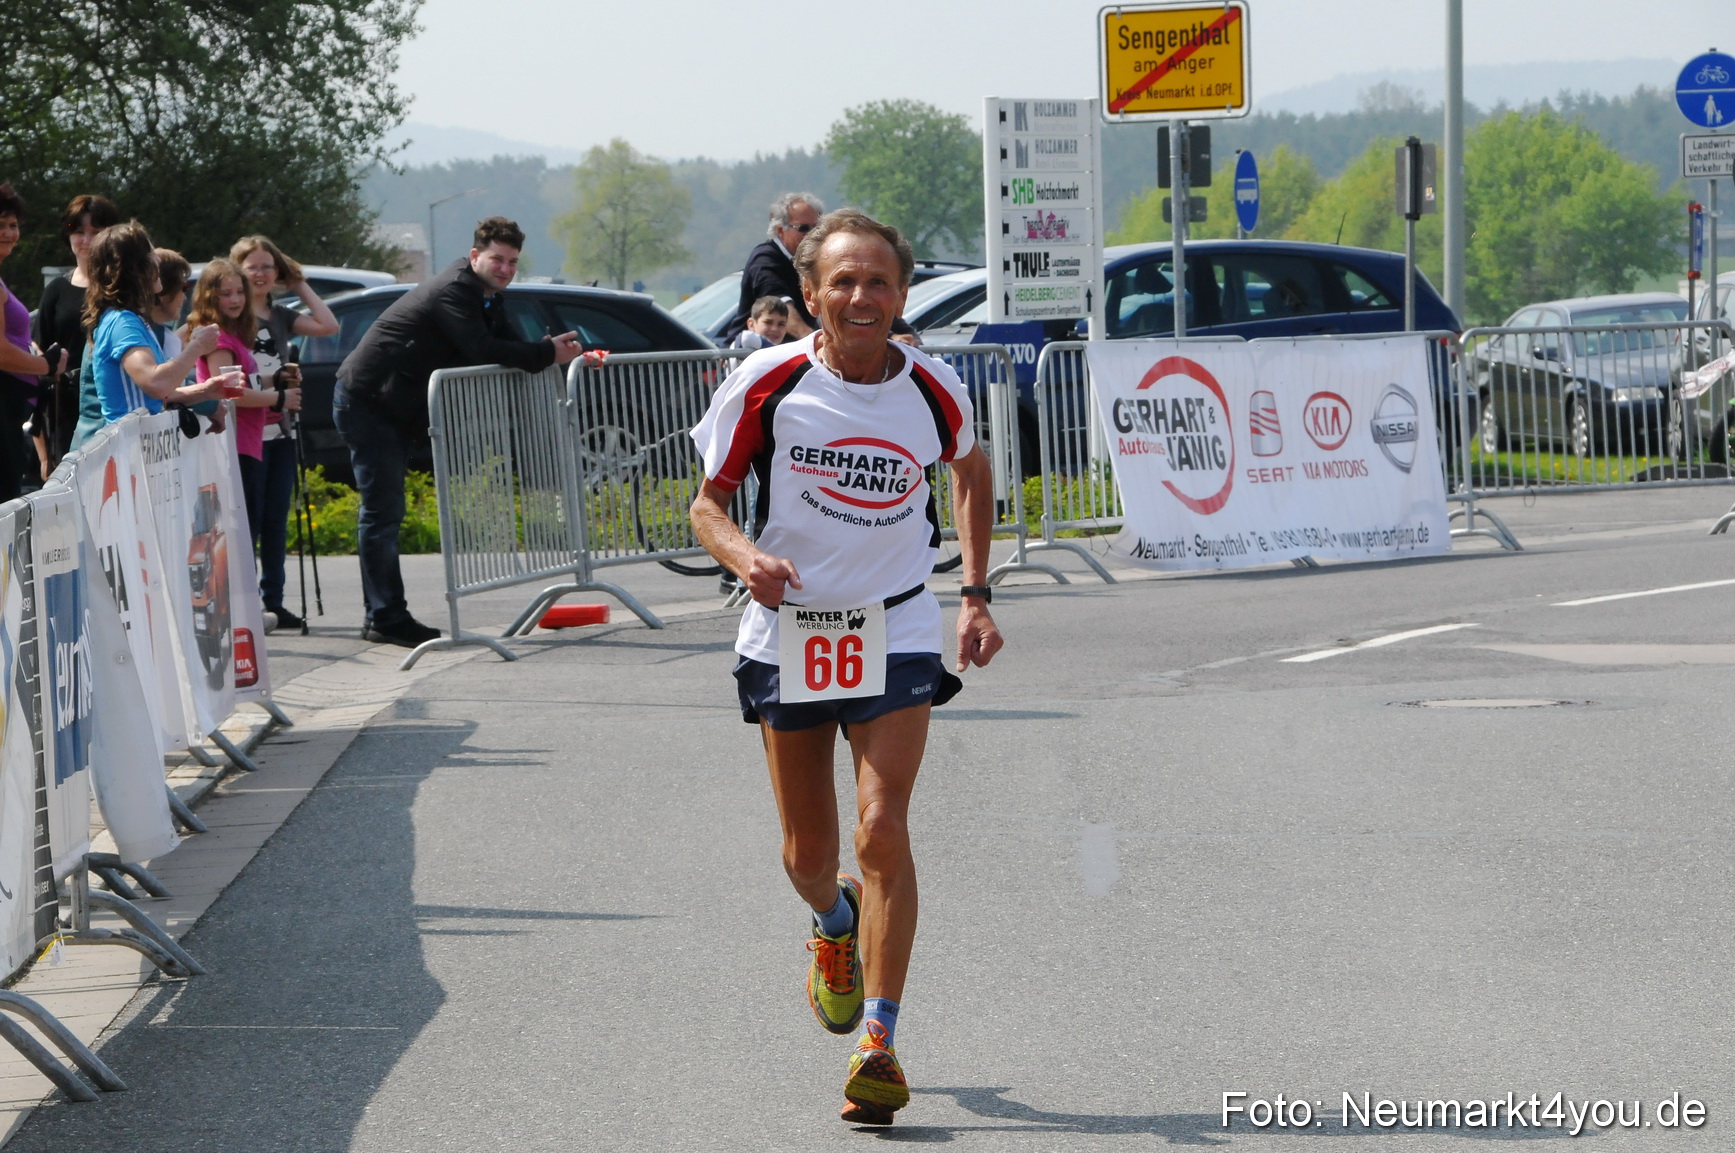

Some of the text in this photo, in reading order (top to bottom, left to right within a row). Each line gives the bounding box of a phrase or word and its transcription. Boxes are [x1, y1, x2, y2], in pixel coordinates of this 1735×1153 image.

[1118, 20, 1230, 55] Sengenthal
[1134, 56, 1215, 74] am Anger
[1146, 85, 1196, 99] Neumarkt
[1034, 102, 1077, 117] HOLZAMMER
[1035, 139, 1078, 154] HOLZAMMER
[1688, 150, 1735, 161] schaftliche
[1688, 163, 1720, 173] Verkehr
[1012, 178, 1079, 206] SHB Holzfachmarkt
[1013, 252, 1050, 278] THULE
[1112, 397, 1207, 434] GERHART
[1310, 406, 1343, 436] KIA
[789, 445, 903, 476] GERHART
[1166, 434, 1227, 471] JÄNIG
[790, 463, 839, 478] Autohaus
[1247, 467, 1294, 484] SEAT
[1302, 459, 1369, 480] KIA MOTORS
[837, 471, 908, 494] JÄNIG
[801, 490, 914, 528] Das sportliche Autohaus
[1130, 536, 1187, 559] Neumarkt
[796, 610, 844, 622] MEYER
[796, 621, 845, 630] WERBUNG
[236, 659, 253, 669] KIA
[804, 634, 864, 692] 66
